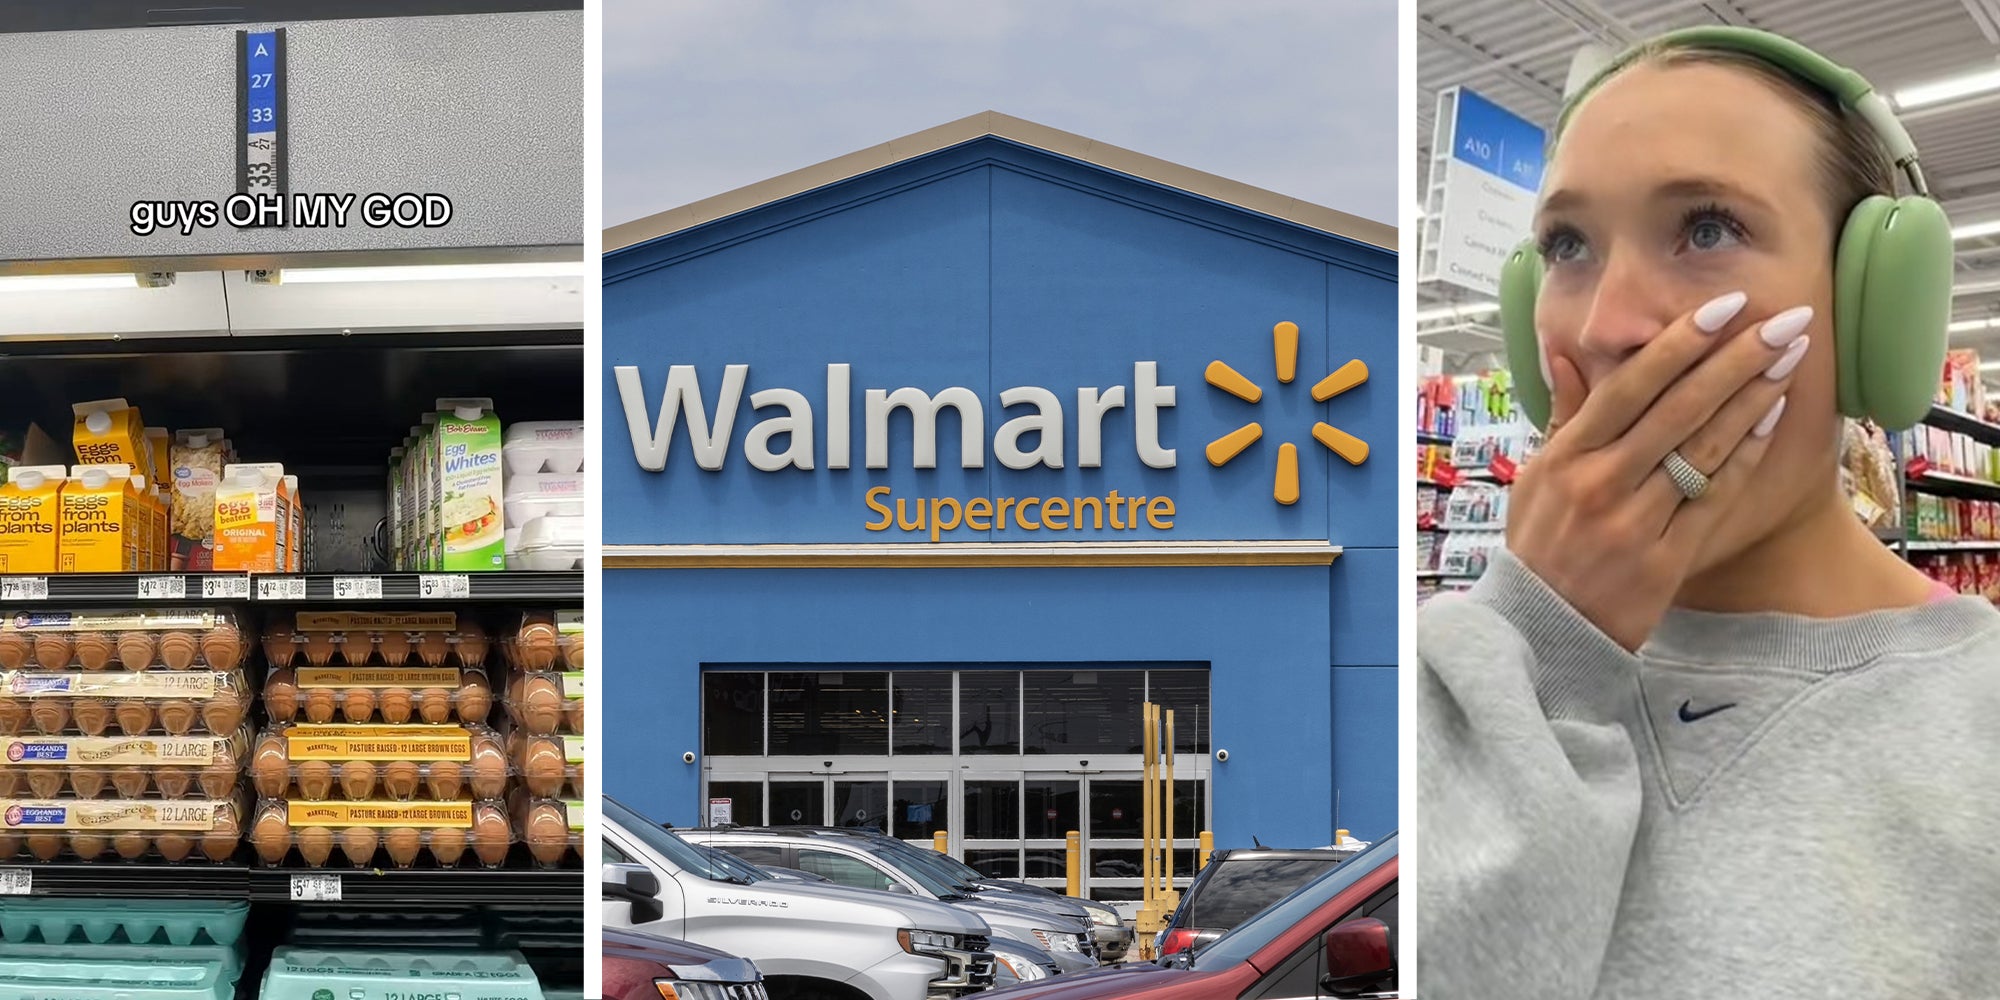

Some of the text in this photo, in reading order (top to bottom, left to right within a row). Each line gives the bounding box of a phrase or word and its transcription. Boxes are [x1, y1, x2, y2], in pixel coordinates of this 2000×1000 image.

[254, 43, 268, 57] A
[251, 73, 273, 88] 27
[251, 107, 273, 122] 33
[248, 140, 259, 148] A
[259, 138, 270, 150] 27
[247, 163, 271, 187] 33
[614, 361, 1177, 472] Walmart
[446, 424, 462, 433] Bob
[77, 443, 120, 456] Eggs
[445, 444, 466, 456] Egg
[80, 455, 121, 464] from
[445, 453, 497, 473] Whites
[0, 495, 42, 510] Eggs
[63, 495, 108, 510] Eggs
[218, 501, 250, 516] egg
[62, 507, 107, 520] from
[219, 513, 252, 524] beaters
[865, 486, 1176, 542] Supercentre
[62, 521, 120, 536] plants
[223, 529, 267, 537] ORIGINAL
[177, 677, 209, 689] LARGE
[162, 743, 207, 757] 12 LARGE
[306, 743, 466, 754] MARKETSIDE PASTURE RAISED 12 LARGE BROWN EGGS
[162, 807, 207, 821] 12 LARGE
[306, 809, 468, 820] MARKETSIDE PASTURE RAISED 12 LARGE BROWN EGGS
[707, 897, 789, 908] SILVERADO
